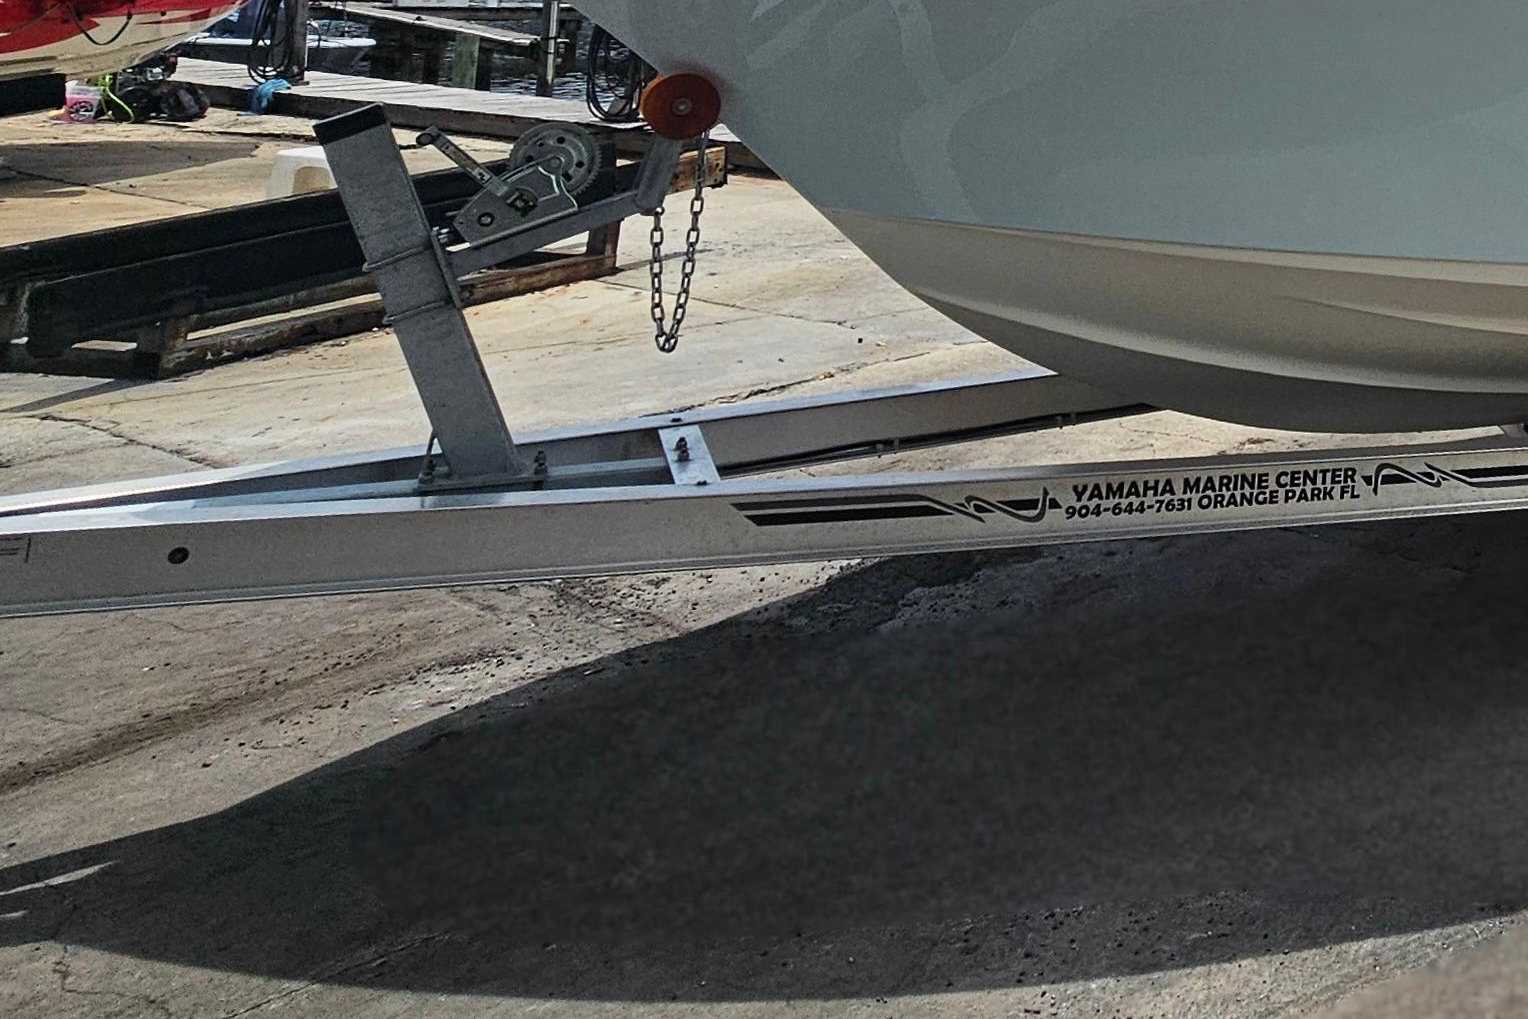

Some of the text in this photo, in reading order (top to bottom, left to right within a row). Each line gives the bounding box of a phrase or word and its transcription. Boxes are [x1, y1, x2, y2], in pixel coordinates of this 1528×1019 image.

[1065, 484, 1361, 520] 904-644-7631 ORANGE PARK FL
[1072, 467, 1358, 503] YAMAHA MARINE CENTER
